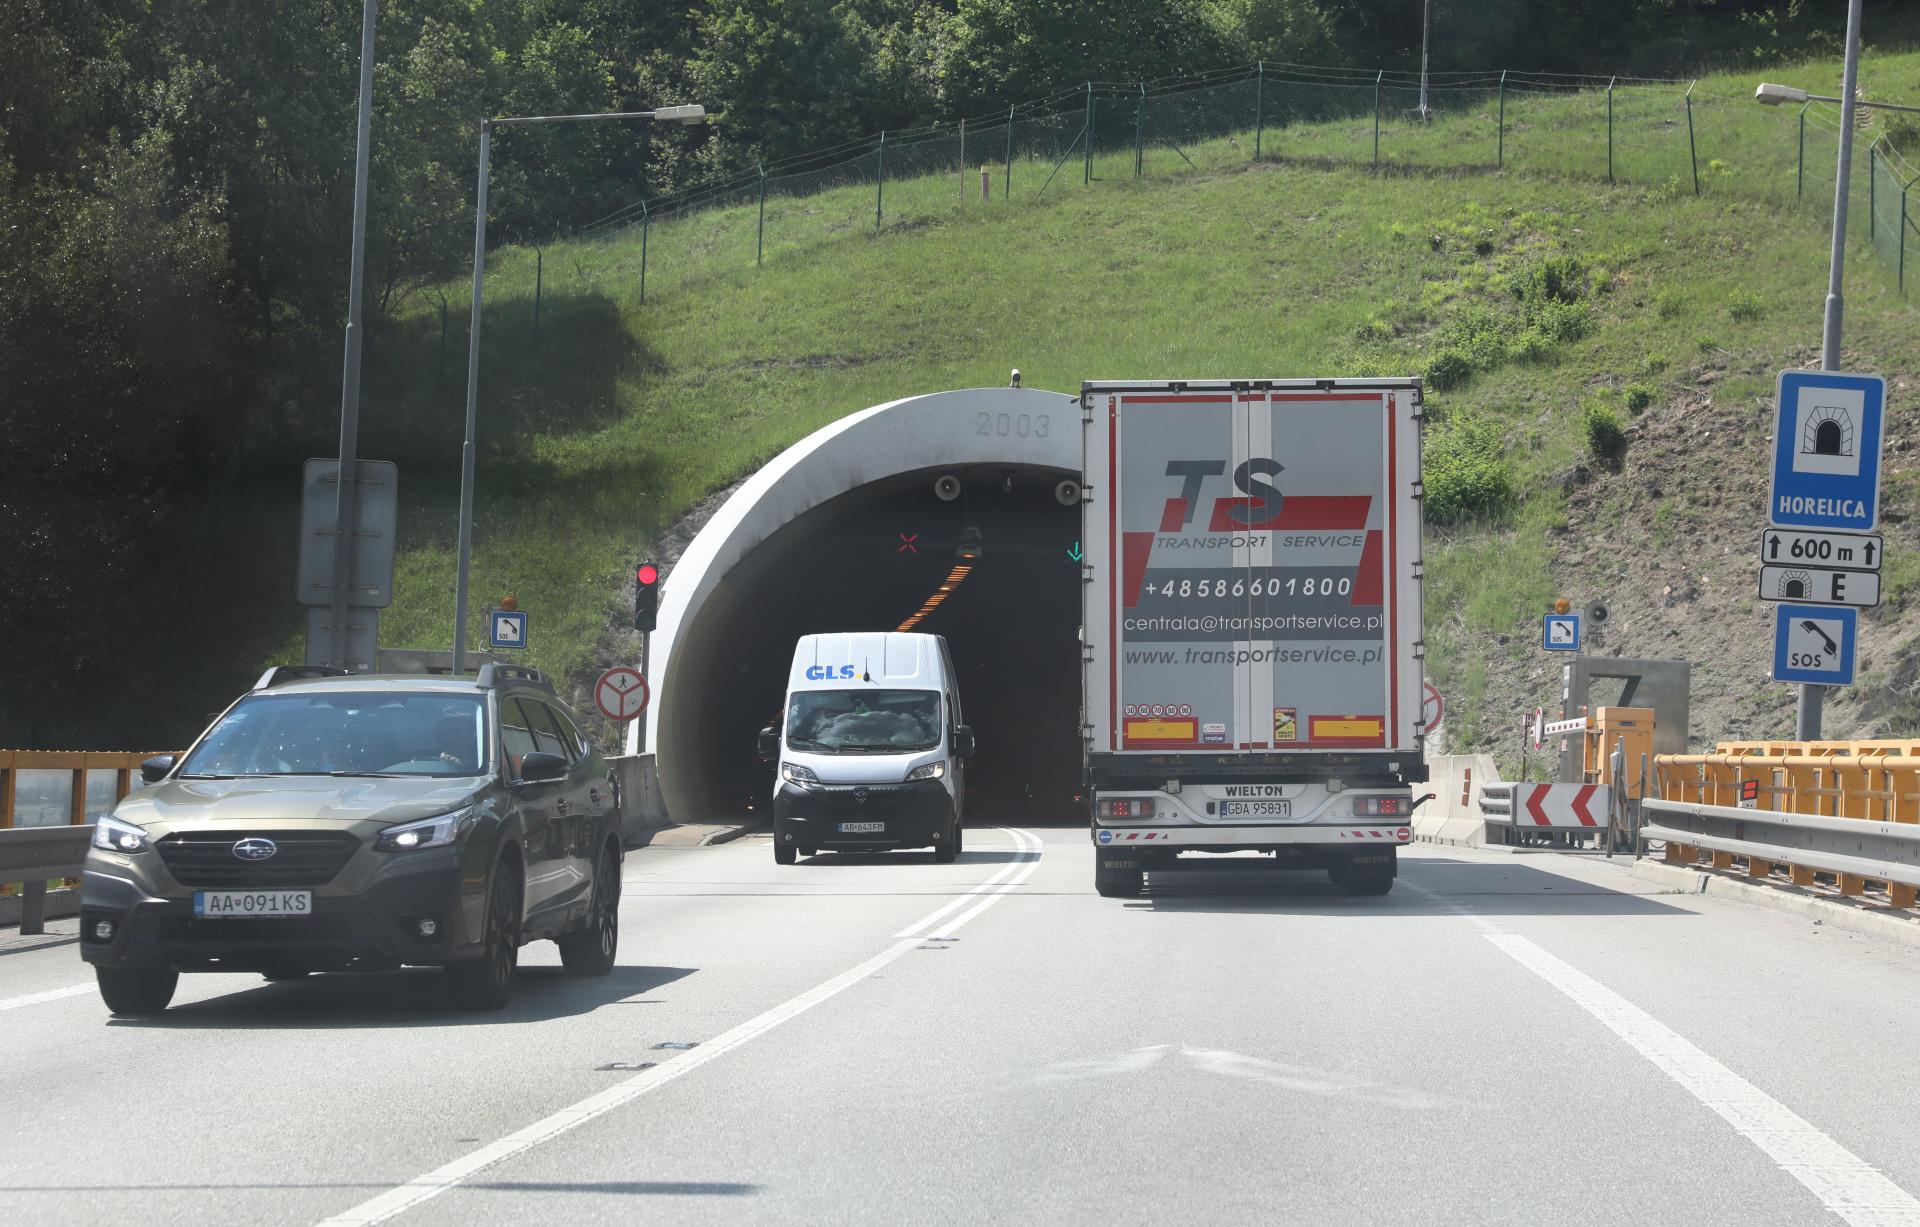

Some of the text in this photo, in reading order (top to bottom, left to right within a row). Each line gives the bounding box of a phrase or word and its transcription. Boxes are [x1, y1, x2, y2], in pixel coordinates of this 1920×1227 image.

[976, 412, 1050, 438] 2003
[1165, 458, 1286, 525] TS
[1779, 496, 1866, 519] HORELICA
[1157, 535, 1364, 549] TRANSPORT SERVICE
[1790, 538, 1853, 561] 600 m
[1145, 577, 1352, 598] +48586601800
[1831, 573, 1846, 600] E
[1124, 614, 1384, 632] centrala@transportservice.pl
[1791, 652, 1822, 668] SOS
[1225, 786, 1283, 796] WIELTON
[1228, 803, 1250, 814] GDA
[1253, 803, 1287, 814] 95831
